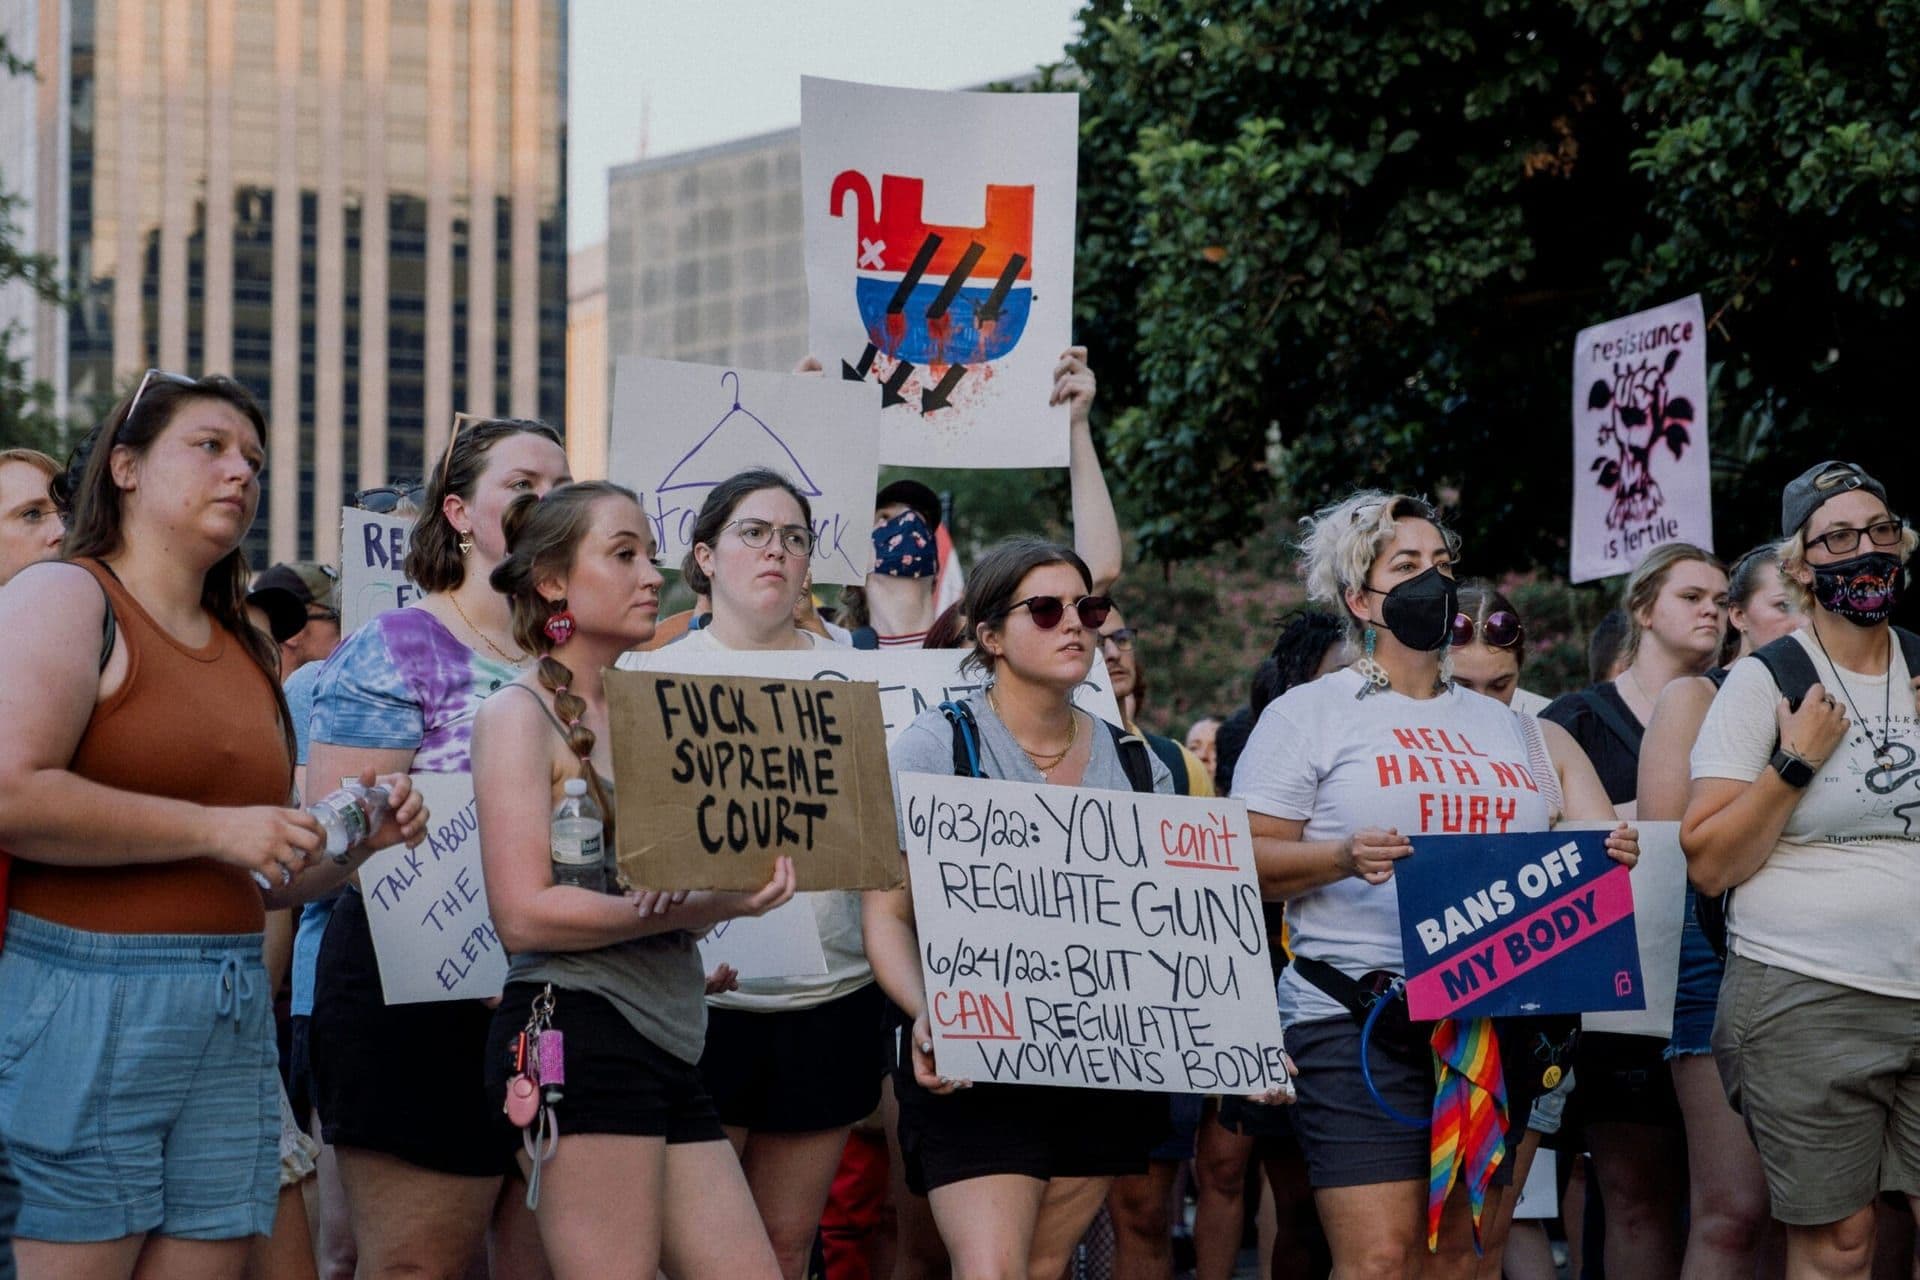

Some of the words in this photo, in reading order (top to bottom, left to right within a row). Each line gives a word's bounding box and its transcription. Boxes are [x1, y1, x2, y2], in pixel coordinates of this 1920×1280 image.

[1591, 321, 1694, 363] resistance
[1603, 538, 1618, 561] is
[1622, 517, 1679, 553] fertile
[654, 678, 758, 741] FUCK
[760, 683, 843, 746] THE
[1392, 727, 1489, 757] HELL
[671, 738, 839, 796] SUPREME
[1375, 754, 1480, 787] HATH
[696, 794, 828, 854] COURT
[907, 793, 1041, 857] 6/23/22:
[1034, 792, 1148, 869] YOU
[1159, 811, 1240, 866] can't
[1418, 792, 1517, 834] FURY
[370, 847, 425, 912] TALK
[427, 797, 478, 862] ABOU
[421, 866, 480, 932] THE
[938, 861, 1121, 927] REGULATE
[1131, 880, 1262, 956] GUNS
[1415, 879, 1516, 956] BANS
[1517, 840, 1584, 900] OFF
[926, 937, 1061, 988] 6/24/22:
[1064, 944, 1142, 998] BUT
[1147, 950, 1241, 1002] YOU
[1439, 945, 1499, 1003] MY
[1501, 889, 1599, 969] BODY
[933, 990, 1016, 1034] CAN
[1024, 996, 1215, 1051] REGULATE
[976, 1040, 1166, 1086] WOMEN'S
[1181, 1041, 1290, 1090] BODIES
